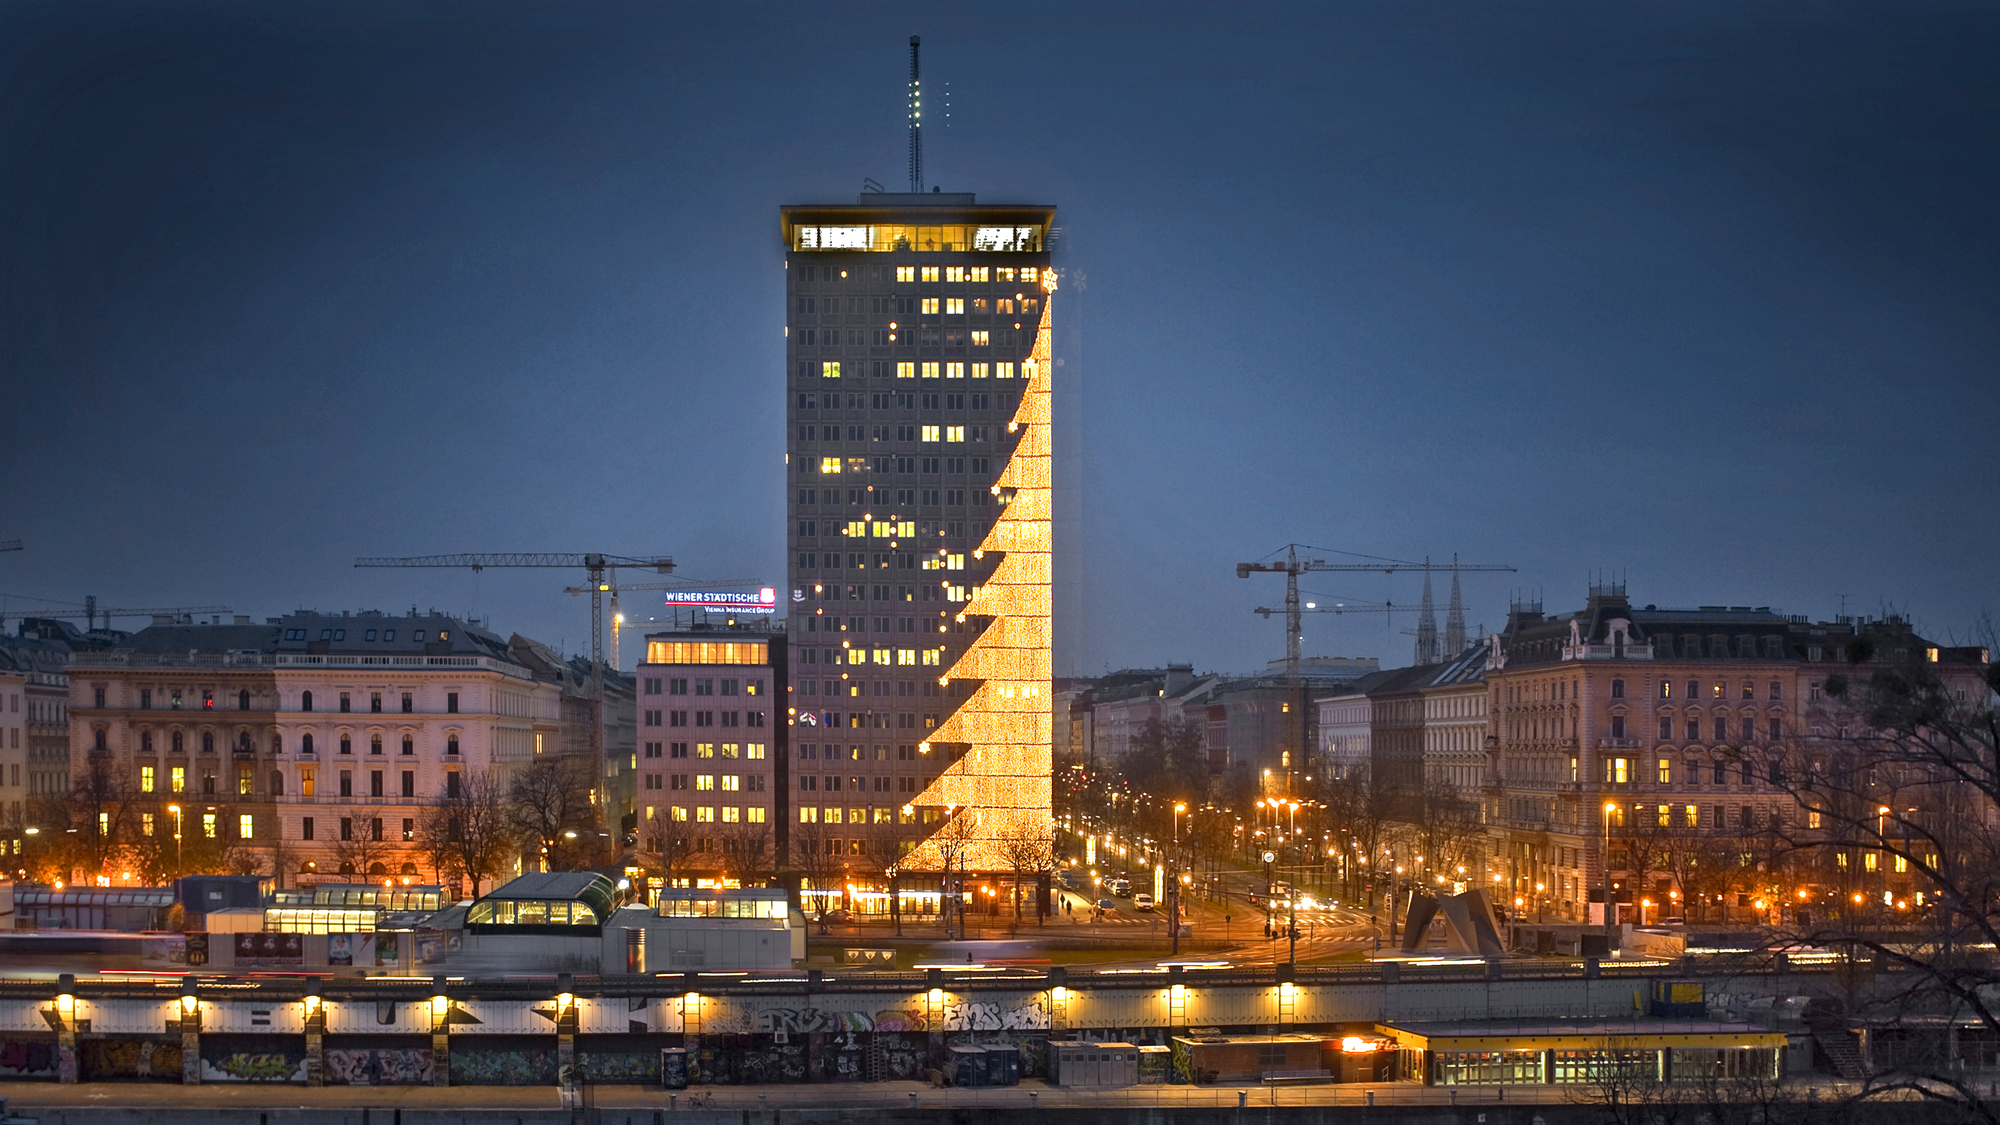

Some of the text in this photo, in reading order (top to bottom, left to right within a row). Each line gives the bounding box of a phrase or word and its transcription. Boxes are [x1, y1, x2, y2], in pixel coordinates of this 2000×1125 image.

[665, 592, 760, 603] WIENER STÄDTISCHE
[726, 606, 756, 614] INSURANCE
